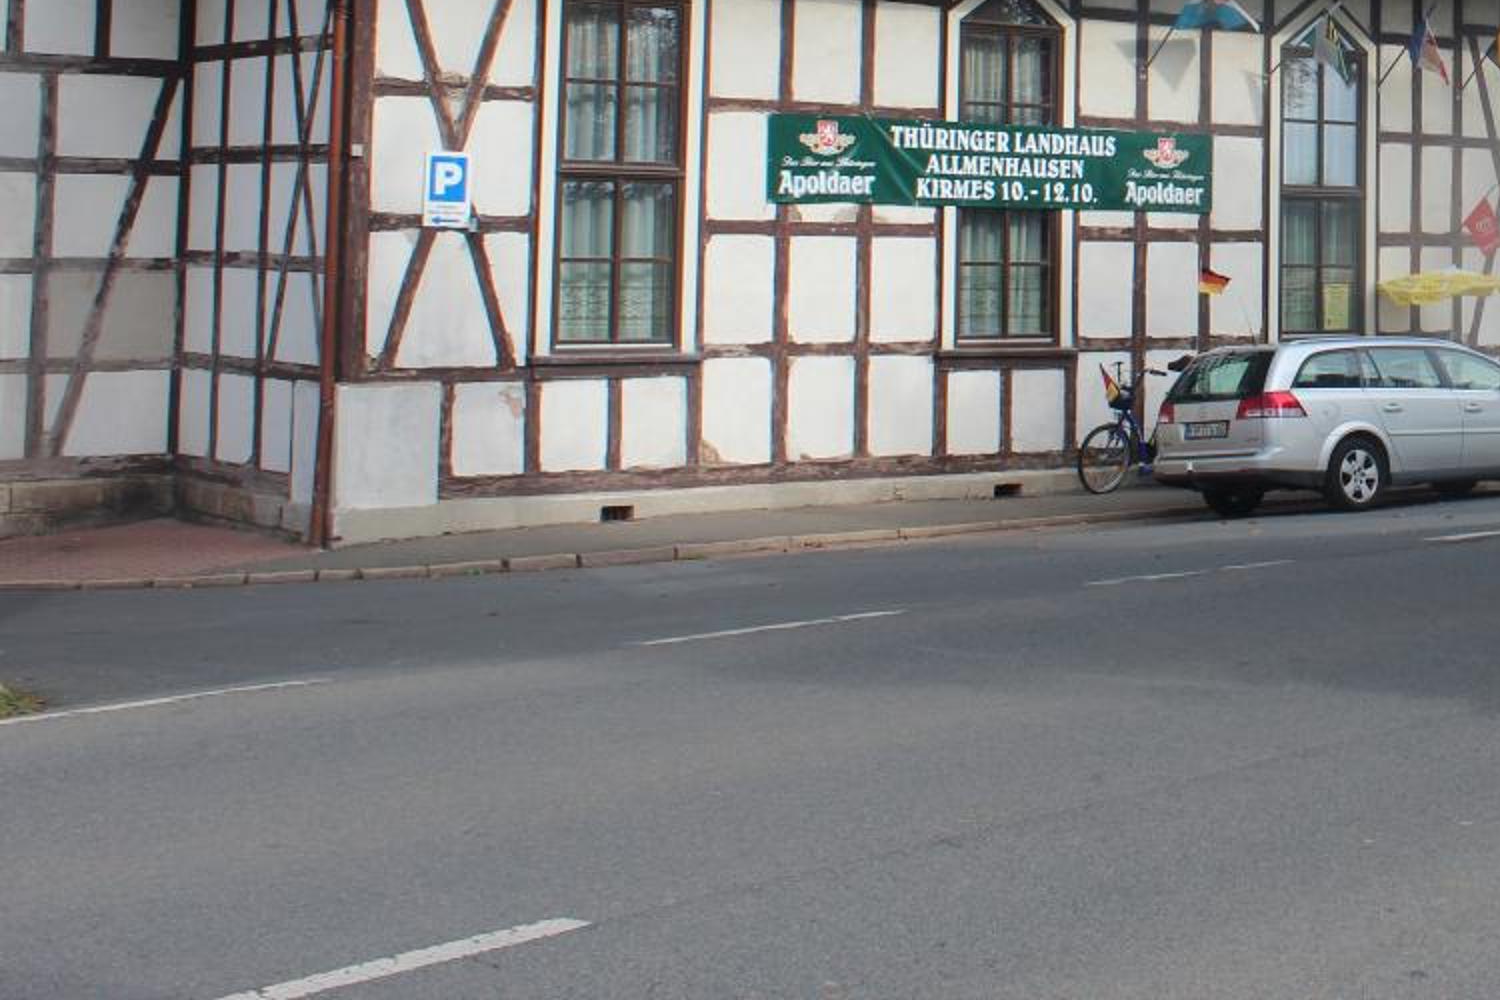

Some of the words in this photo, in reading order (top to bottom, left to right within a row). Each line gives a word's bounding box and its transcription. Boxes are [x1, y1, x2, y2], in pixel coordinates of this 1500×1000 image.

[890, 123, 1009, 153] THÜRINGER
[1014, 131, 1116, 157] LANDHAUS
[435, 161, 463, 195] P
[925, 153, 1084, 179] ALLMENHAUSEN
[778, 170, 876, 198] Apoldaer
[916, 178, 996, 200] KIRMES
[1125, 181, 1204, 206] Apoldaer
